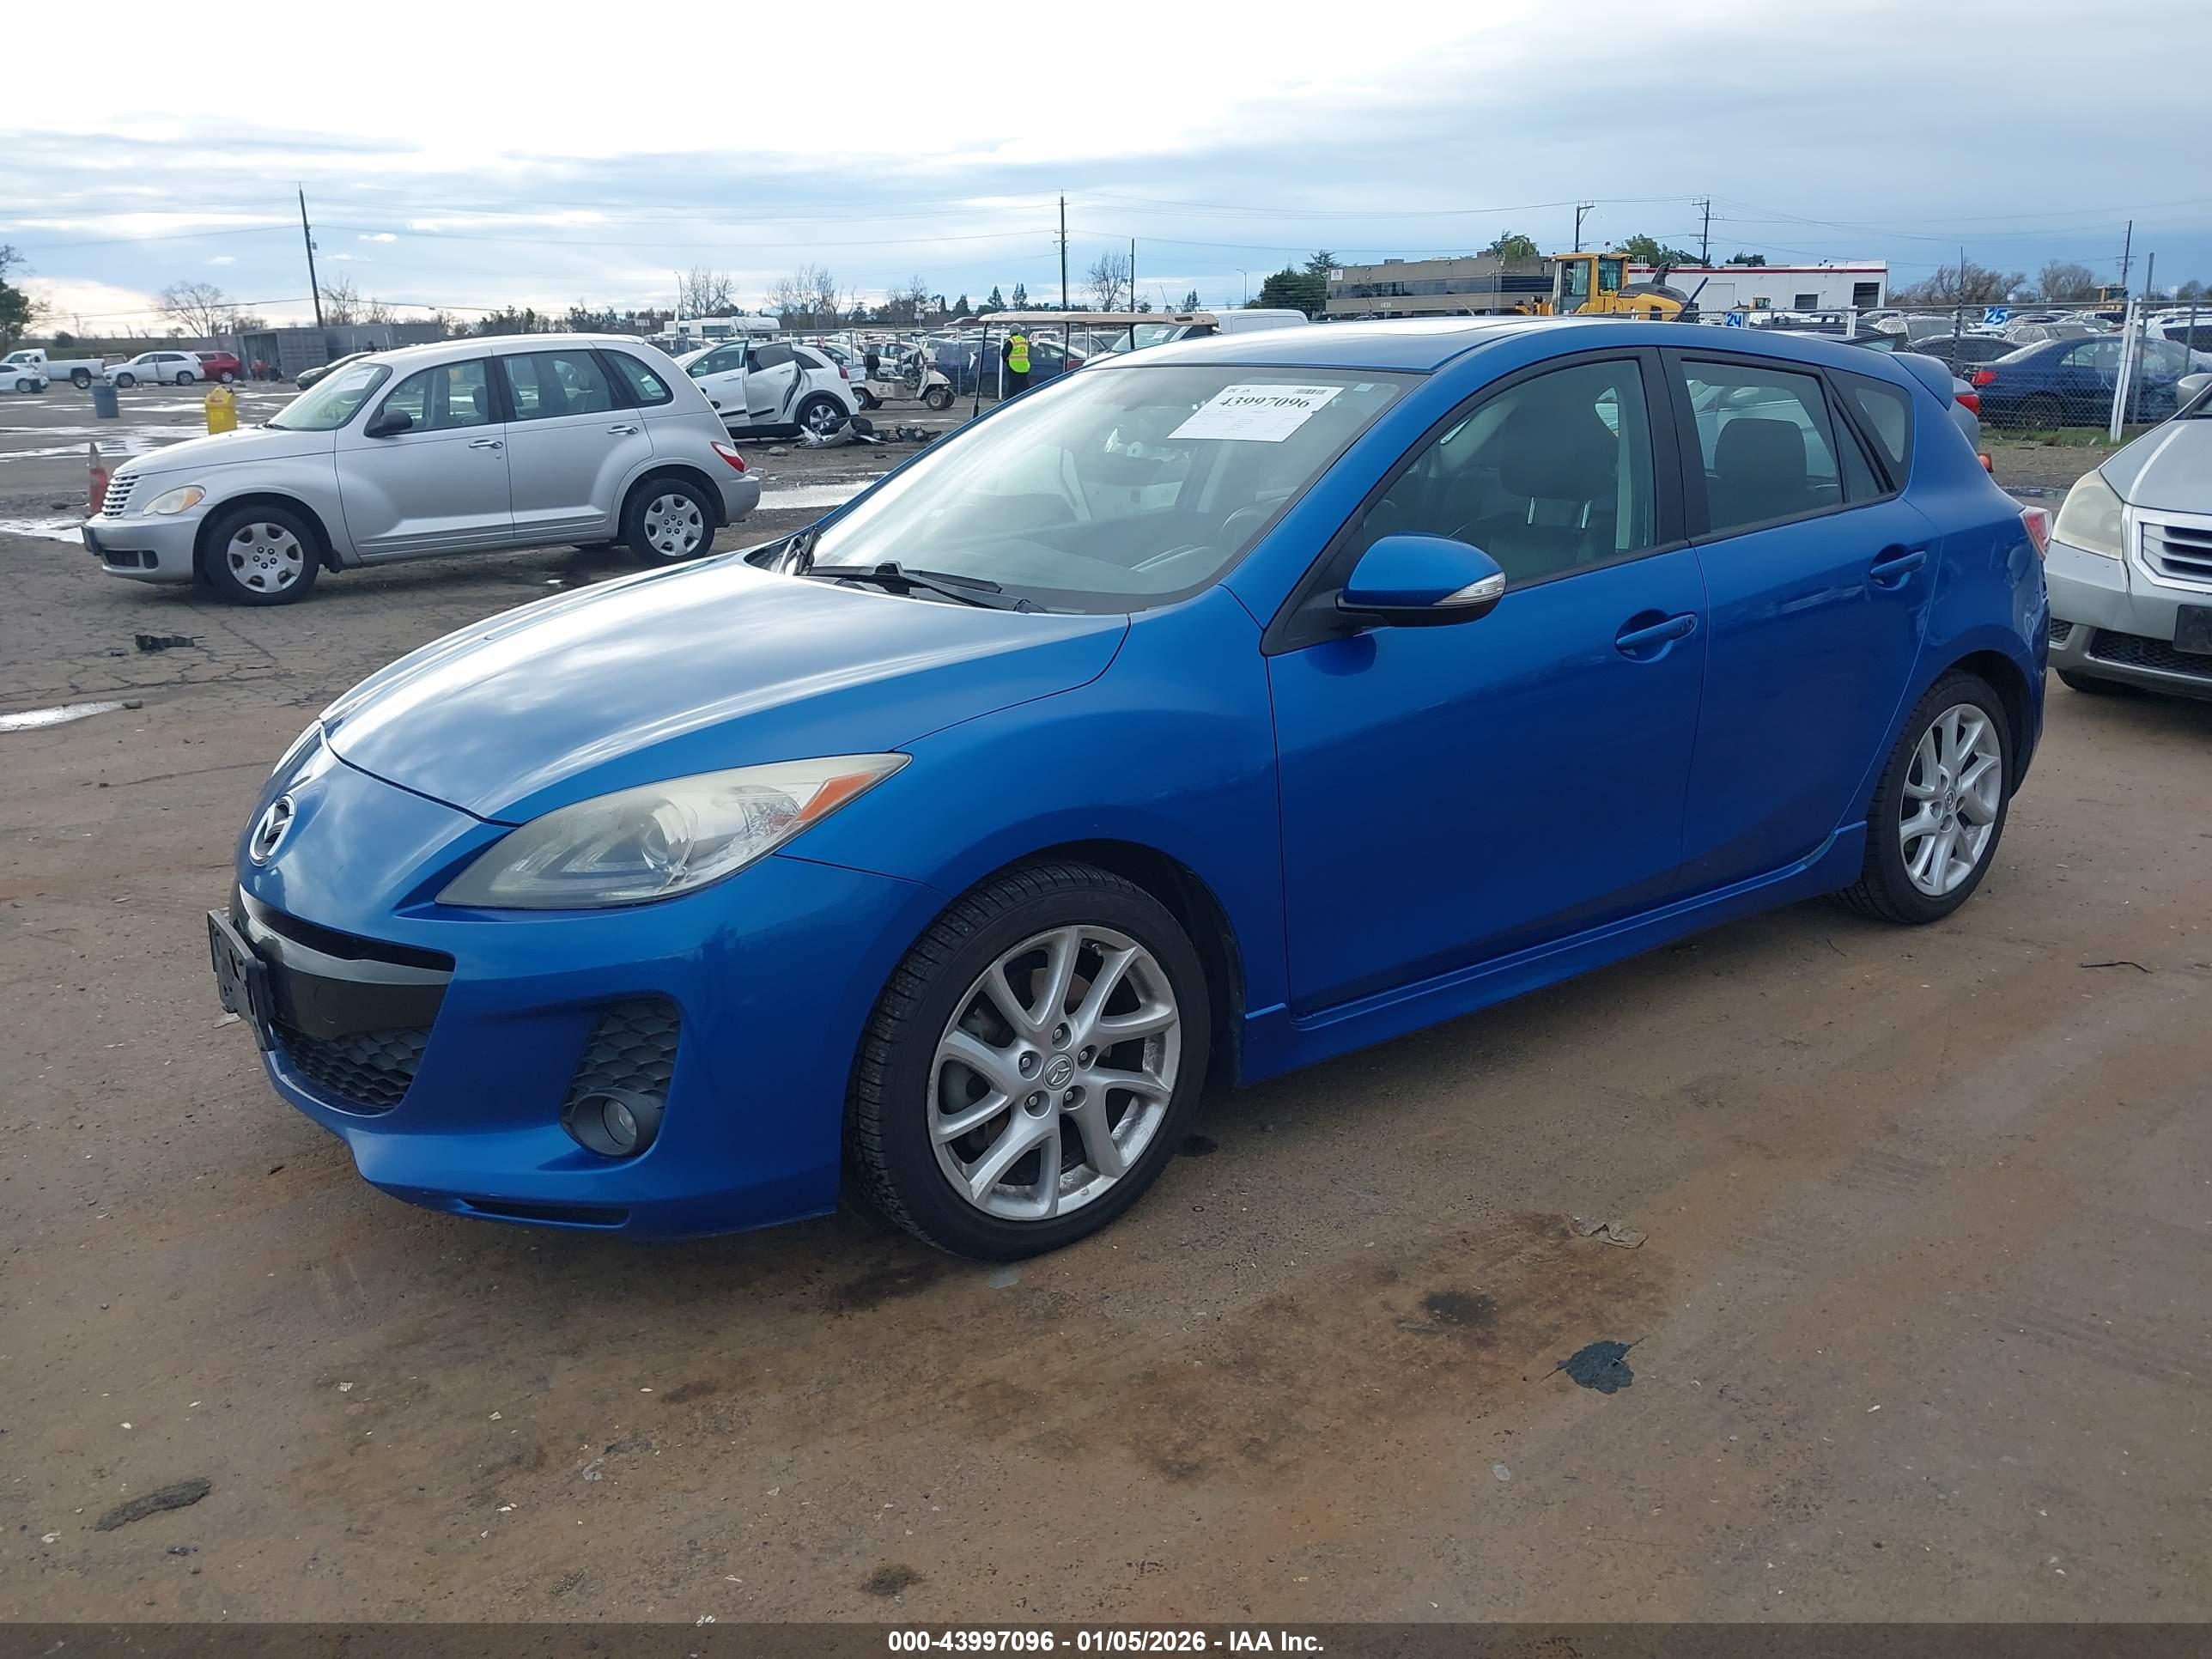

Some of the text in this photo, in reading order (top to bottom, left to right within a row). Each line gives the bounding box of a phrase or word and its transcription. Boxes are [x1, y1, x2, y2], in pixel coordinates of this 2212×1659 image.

[1726, 312, 1741, 327] 24
[1984, 307, 2007, 325] 25
[1219, 396, 1316, 409] 43997096
